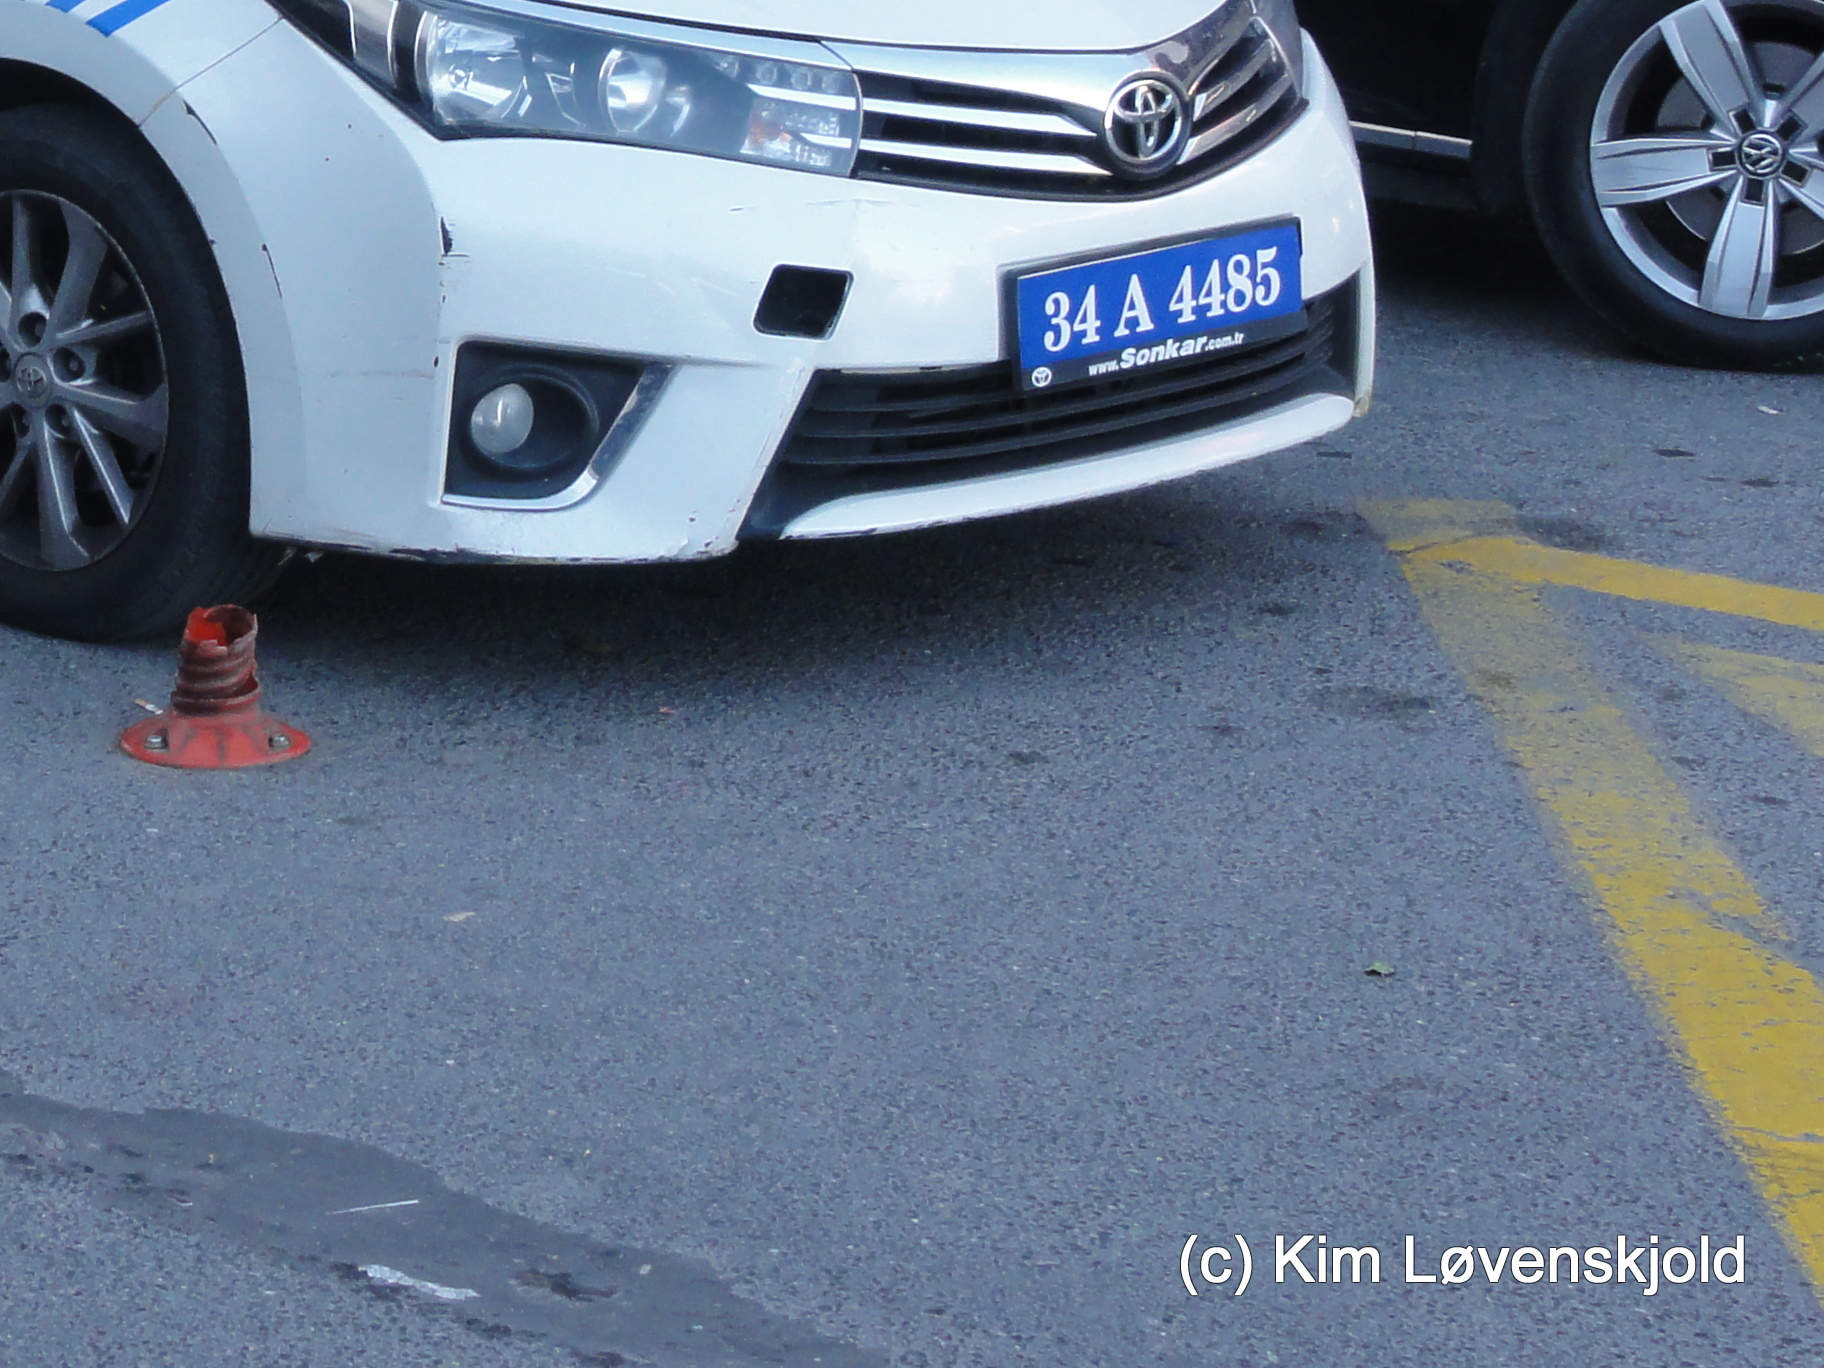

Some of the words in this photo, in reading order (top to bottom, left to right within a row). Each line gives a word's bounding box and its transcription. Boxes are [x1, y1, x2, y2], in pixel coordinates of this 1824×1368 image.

[1042, 283, 1102, 353] 34
[1113, 272, 1155, 338] A
[1168, 245, 1282, 325] 4485
[1088, 330, 1246, 377] www.Sonkar.com.tr
